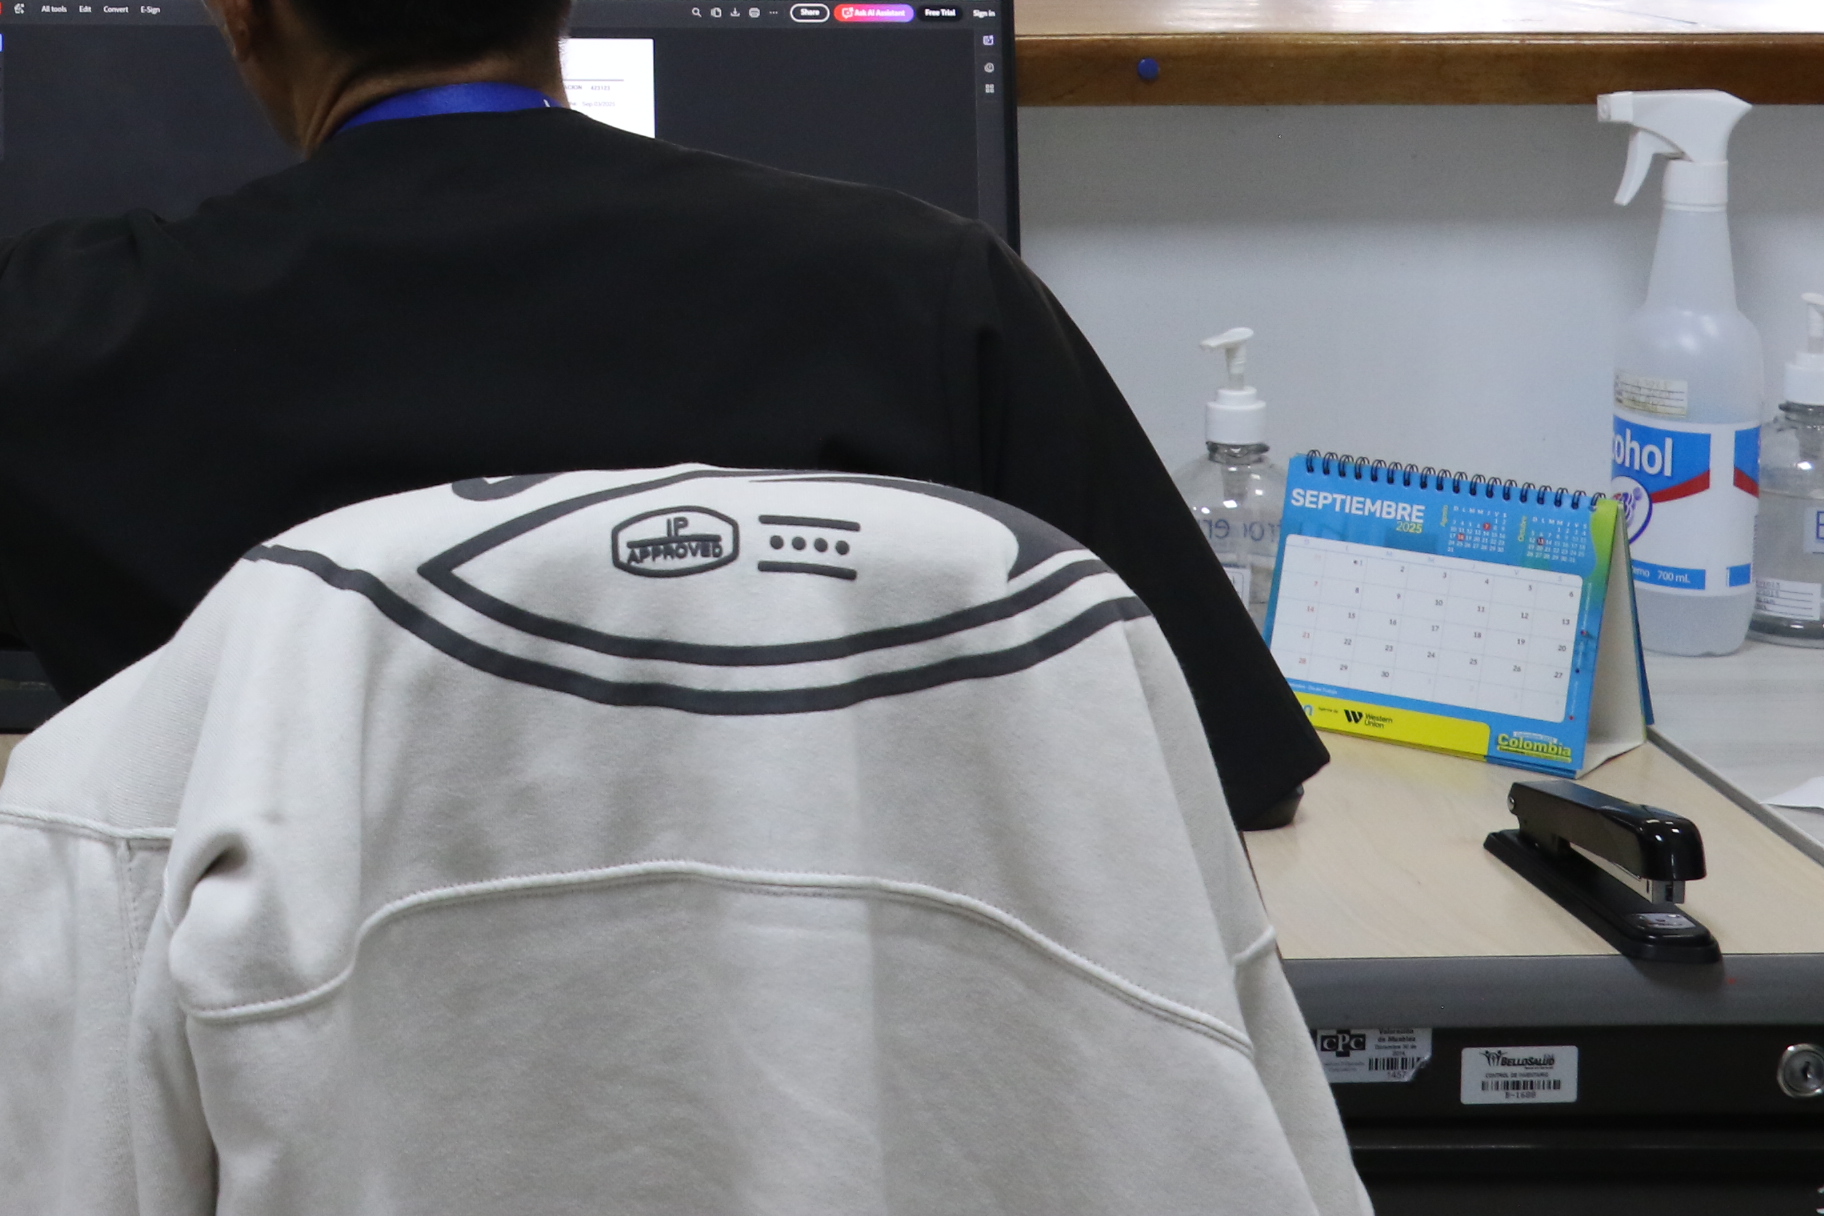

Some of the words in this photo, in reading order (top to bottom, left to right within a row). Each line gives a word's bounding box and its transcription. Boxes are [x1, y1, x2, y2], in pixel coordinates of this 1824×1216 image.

[41, 5, 50, 13] All
[51, 5, 68, 13] tools
[78, 5, 92, 13] Edit
[103, 5, 129, 13] Convert
[140, 5, 161, 15] E-Sign
[800, 8, 820, 16] Share
[854, 9, 867, 17] Ask
[875, 9, 906, 17] Assistant
[924, 9, 939, 17] Free
[940, 9, 956, 17] Trial
[973, 10, 986, 19] Sign
[1291, 488, 1426, 524] SEPTIEMBRE
[666, 517, 689, 536] IP
[1396, 521, 1423, 534] 2025
[626, 541, 723, 566] APPROVED
[1657, 569, 1674, 582] 700
[1477, 605, 1485, 613] 11
[1521, 612, 1529, 620] 12
[1562, 618, 1571, 626] 13
[1473, 631, 1482, 639] 18
[1557, 644, 1567, 652] 20
[1343, 638, 1352, 646] 22
[1384, 644, 1393, 652] 23
[1427, 651, 1435, 659] 24
[1512, 665, 1522, 673] 26
[1553, 671, 1563, 679] 27
[1365, 713, 1393, 724] Western
[1365, 720, 1385, 730] Union
[1497, 733, 1572, 758] Colombia
[1322, 1033, 1364, 1052] CPC
